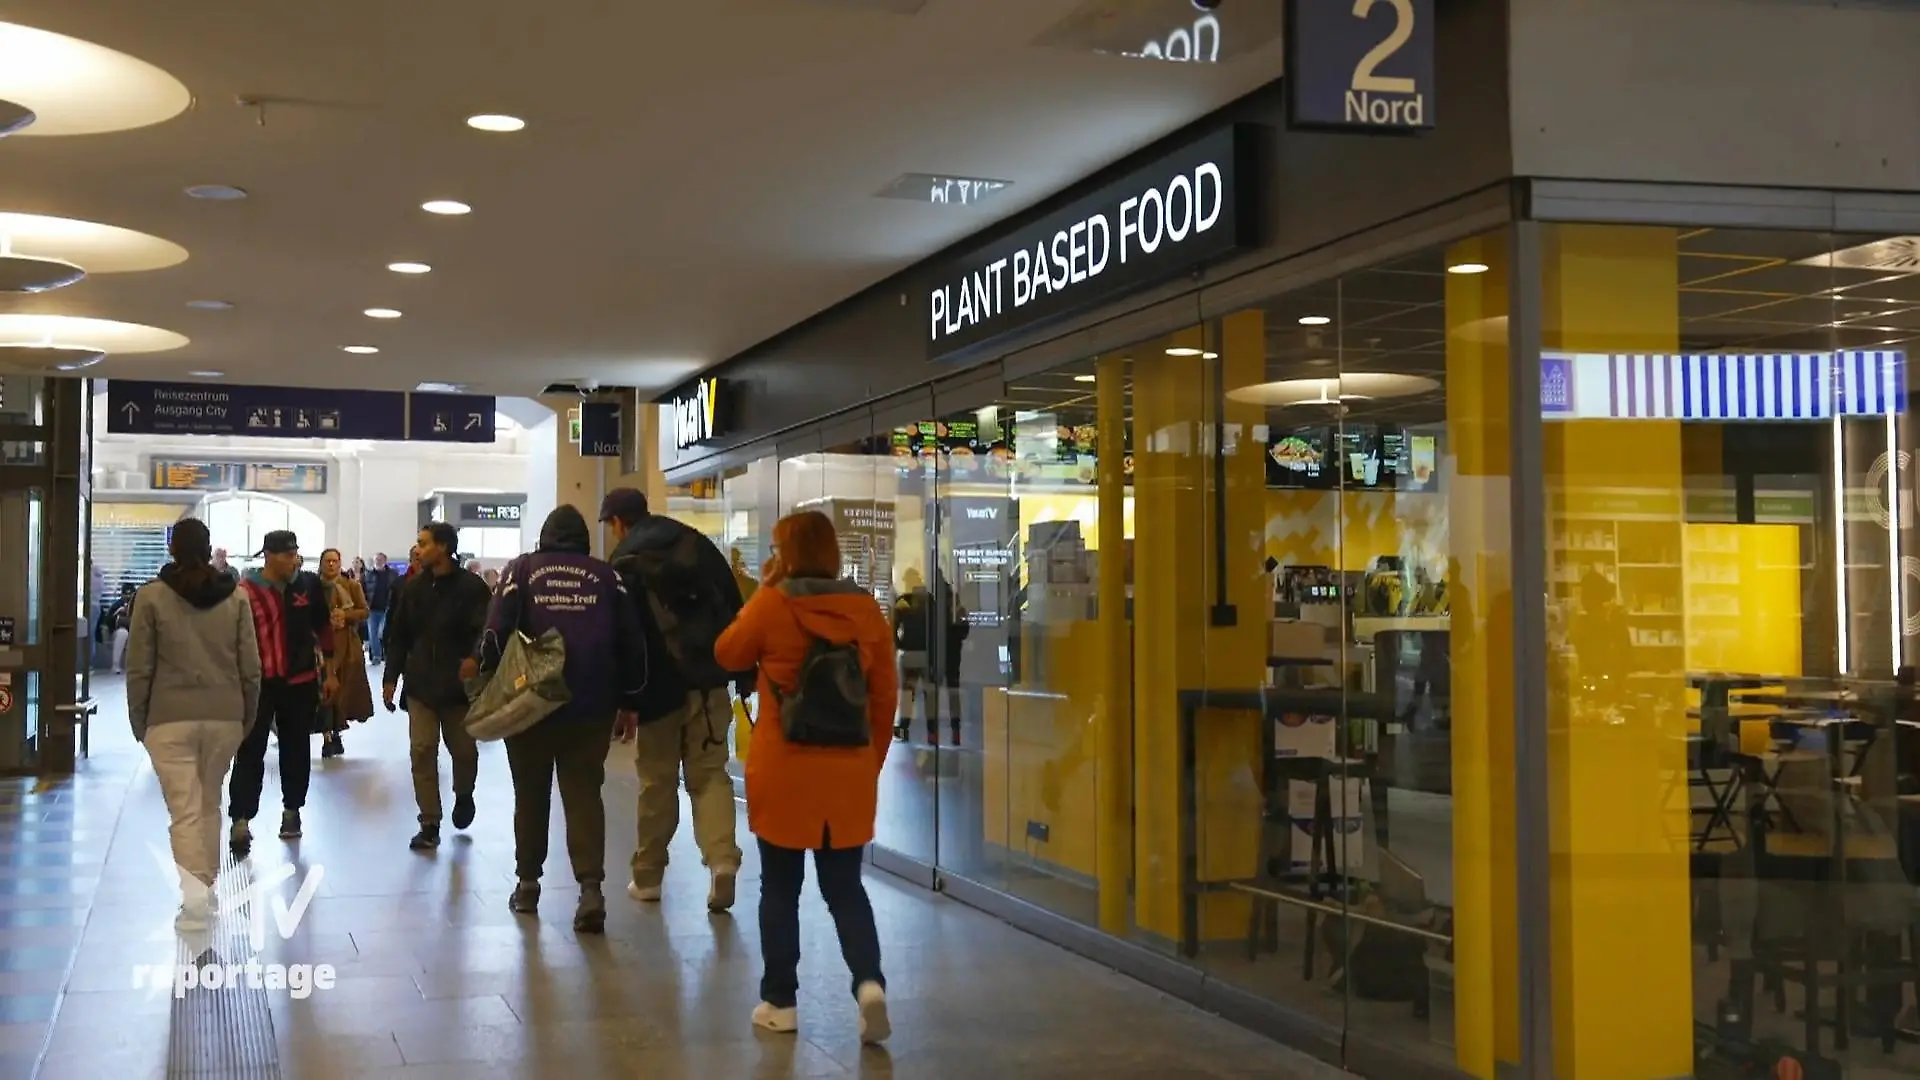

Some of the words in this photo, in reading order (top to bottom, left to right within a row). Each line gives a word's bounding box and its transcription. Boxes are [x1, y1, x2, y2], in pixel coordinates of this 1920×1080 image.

[1352, 0, 1415, 93] 2
[1345, 90, 1423, 125] Nord
[931, 258, 1007, 340] PLANT
[1013, 213, 1110, 307] BASED
[1119, 161, 1222, 263] FOOD
[153, 388, 230, 402] Reisezentrum
[153, 404, 203, 418] Ausgang
[205, 404, 228, 418] City
